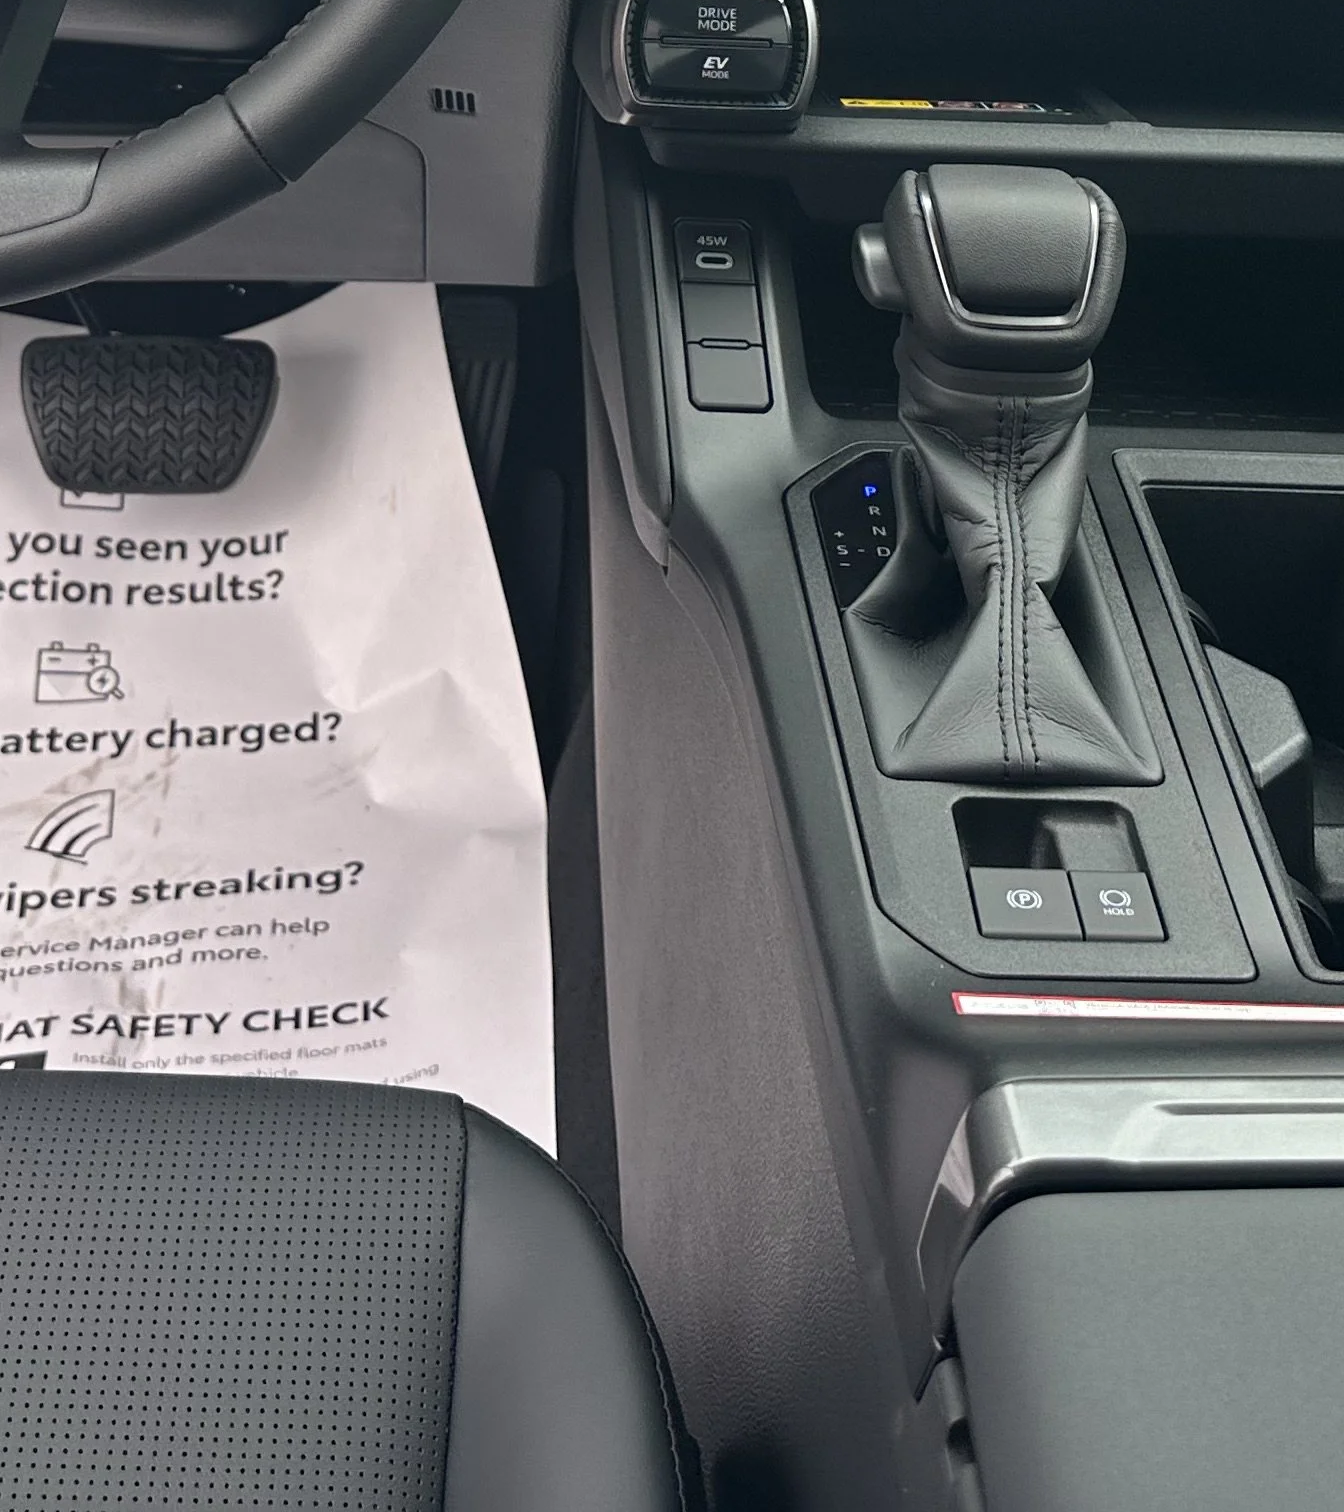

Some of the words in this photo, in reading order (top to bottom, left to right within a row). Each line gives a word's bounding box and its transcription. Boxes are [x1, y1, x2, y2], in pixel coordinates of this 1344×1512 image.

[698, 6, 737, 19] DRIVE
[698, 19, 737, 32] MODE
[703, 56, 730, 69] EV
[701, 70, 729, 79] MODE
[696, 235, 728, 246] 45W
[864, 485, 876, 497] P
[868, 506, 881, 516] R
[872, 526, 887, 536] N
[6, 530, 83, 563] you
[94, 532, 188, 562] seen
[200, 528, 290, 567] your
[836, 544, 849, 555] S
[877, 546, 891, 557] D
[125, 568, 286, 607] results?
[145, 712, 343, 752] charged?
[129, 860, 364, 906] streaking?
[1103, 907, 1135, 916] HOLD
[89, 926, 209, 952] Manager
[214, 922, 262, 938] can
[271, 917, 331, 938] help
[131, 949, 183, 972] and
[191, 946, 268, 964] more.
[70, 1011, 232, 1039] SAFETY
[242, 995, 390, 1033] CHECK
[72, 1051, 127, 1068] Install
[132, 1054, 171, 1071] only
[175, 1048, 206, 1066] the
[209, 1046, 292, 1067] specified
[296, 1042, 340, 1060] floor
[343, 1036, 388, 1053] mats
[393, 1063, 440, 1085] using
